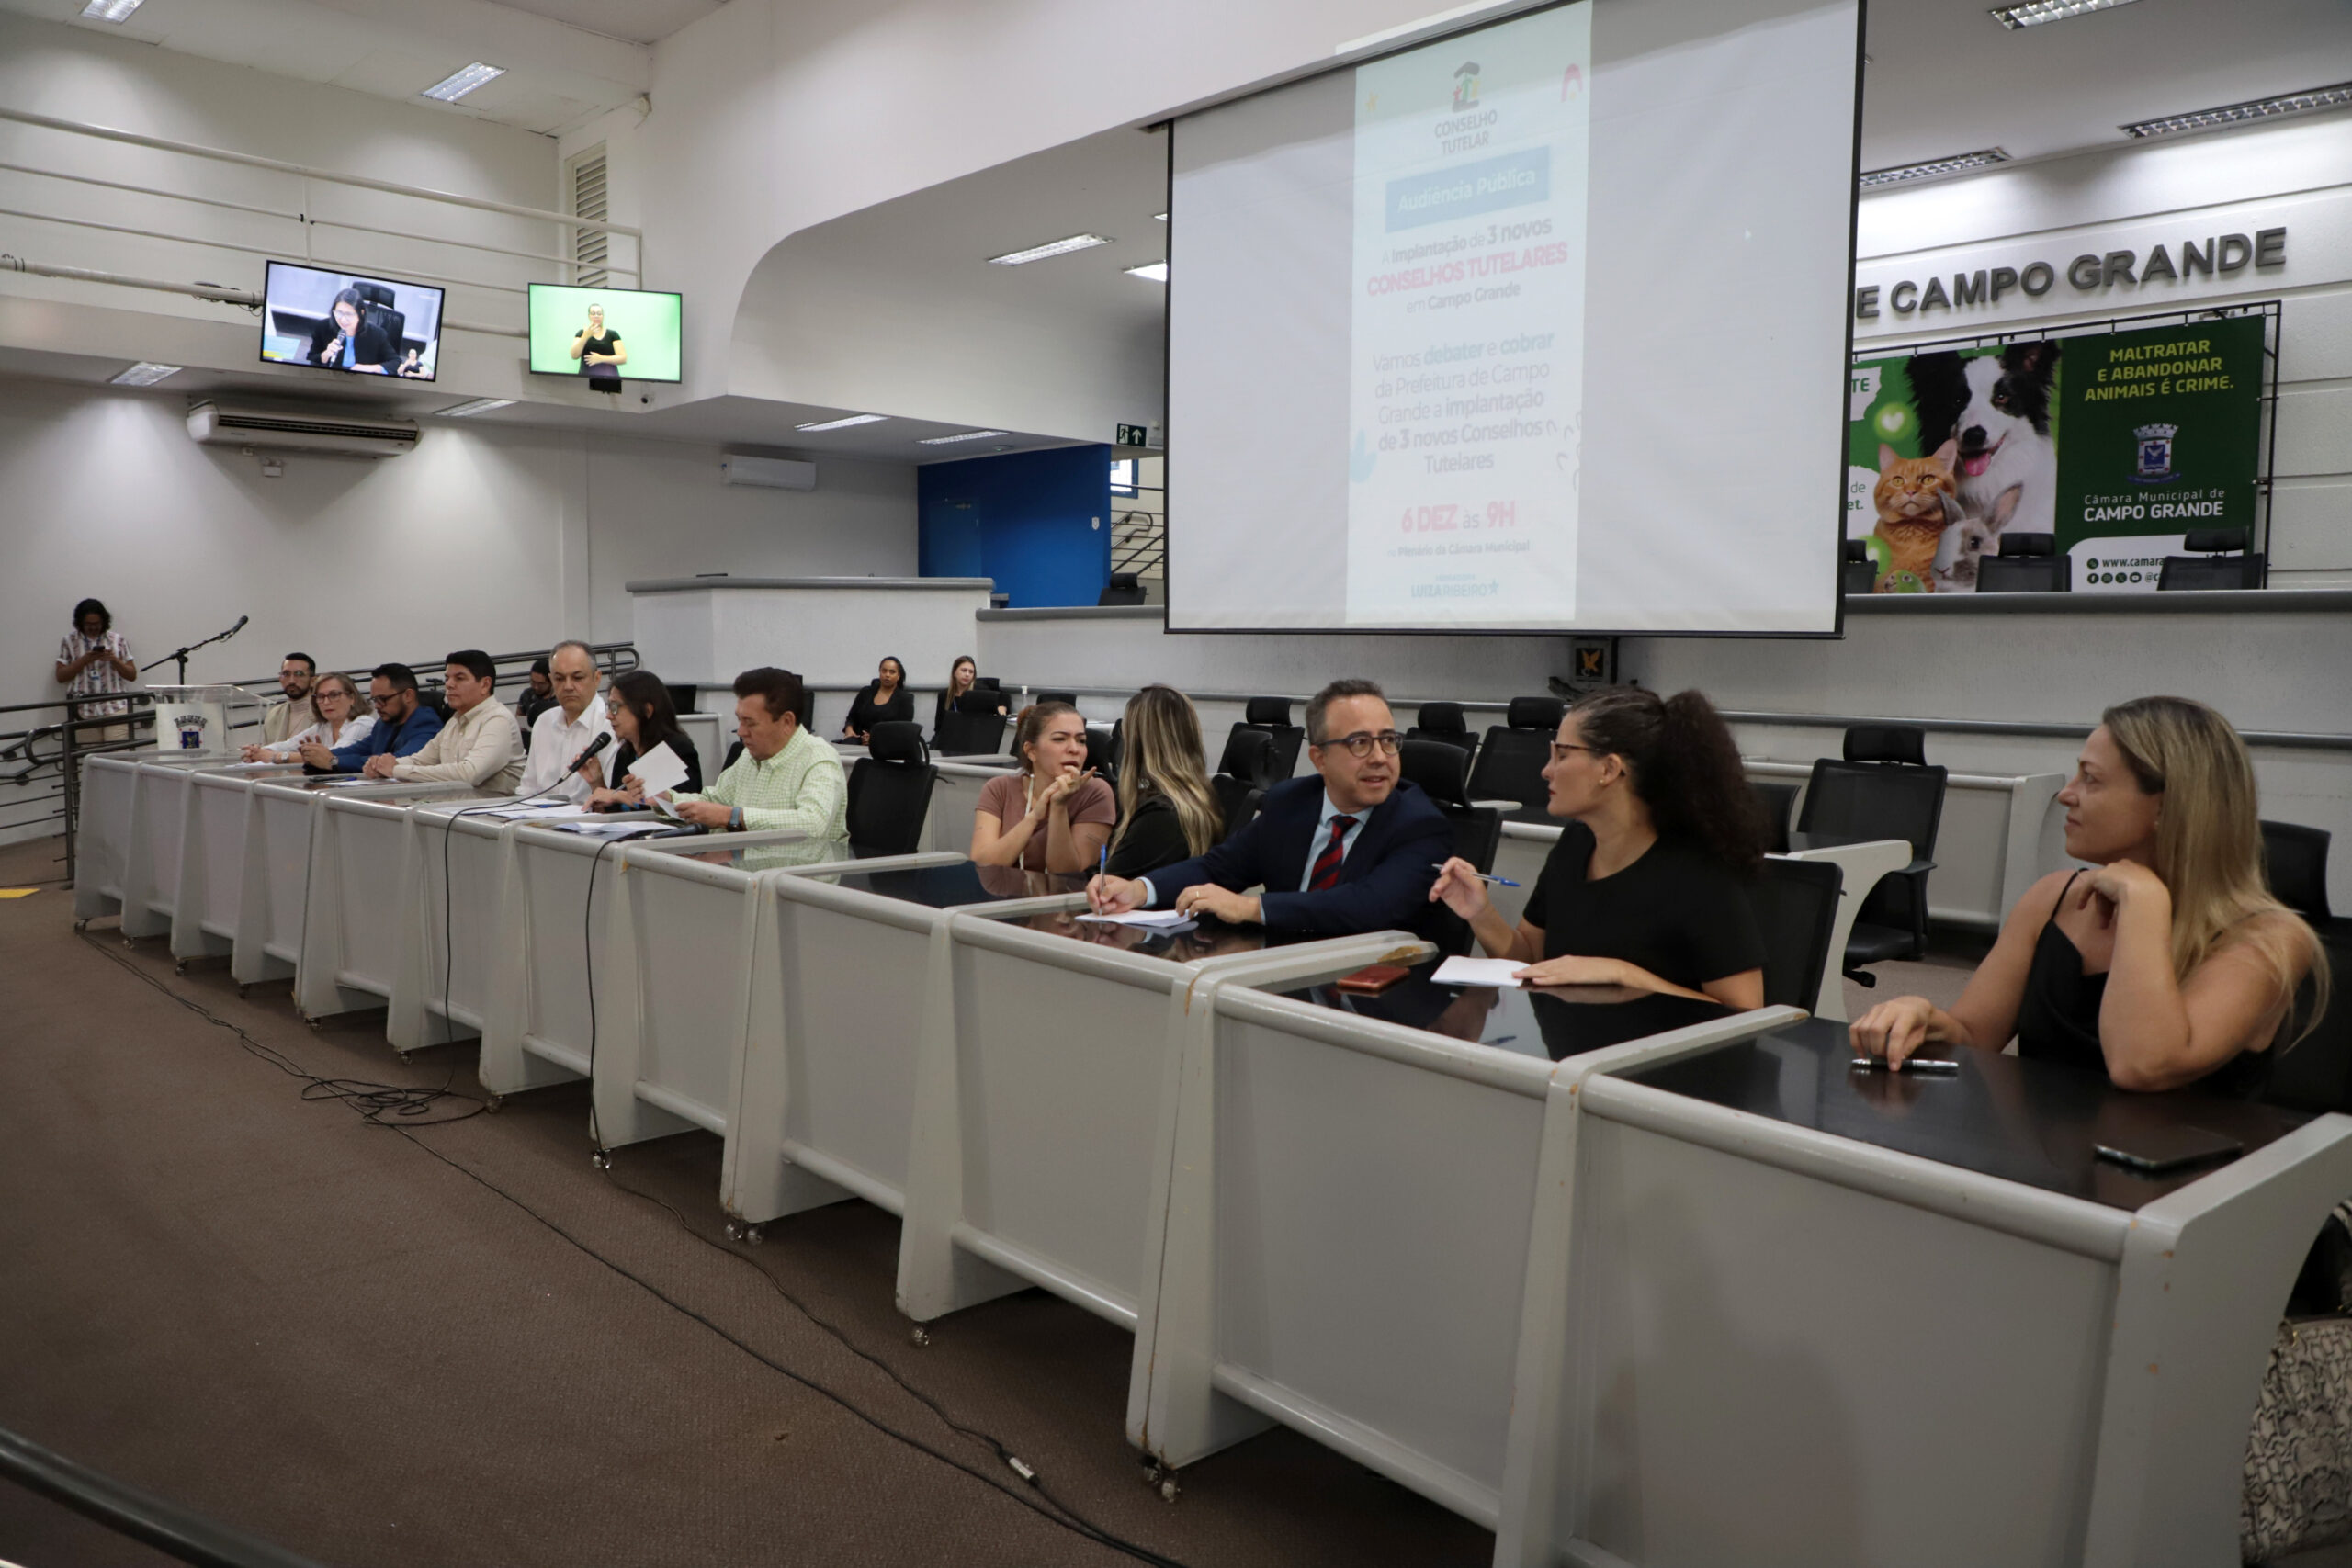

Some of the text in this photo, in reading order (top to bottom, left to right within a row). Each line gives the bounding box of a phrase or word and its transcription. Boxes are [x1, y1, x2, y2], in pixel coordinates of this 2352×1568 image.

[1434, 109, 1498, 138] CONSELHO
[1442, 131, 1489, 154] TUTELAR
[1397, 167, 1535, 213] Audiência Pública
[1392, 236, 1467, 265] Implantação
[1469, 231, 1485, 247] de
[1487, 224, 1498, 244] 3
[1501, 218, 1553, 243] novos
[1367, 241, 1568, 297] CONSELHOS TUTELARES
[1856, 226, 2287, 319] E CAMPO GRANDE
[1407, 281, 1521, 313] em Campo Grande
[1373, 332, 1555, 372] Vamos debater e cobrar
[2109, 340, 2211, 363] MALTRATAR
[1375, 362, 1550, 399] da Prefeitura de Campo
[2097, 357, 2222, 382] E ABANDONAR
[1851, 378, 1870, 393] TE
[2085, 375, 2234, 402] ANIMAIS É CRIME.
[1378, 388, 1544, 425] Grande a implantação
[1378, 418, 1543, 451] de 3 novos Conselhos
[1424, 452, 1494, 474] Tutelares
[1850, 481, 1866, 493] de
[2084, 488, 2225, 505] Câmara Municipal de
[1401, 500, 1516, 533] 6 DEZ às 9H
[1847, 499, 1864, 510] et.
[2084, 501, 2223, 522] CAMPO GRANDE
[1435, 543, 1446, 556] da
[2102, 558, 2164, 568] www.camara
